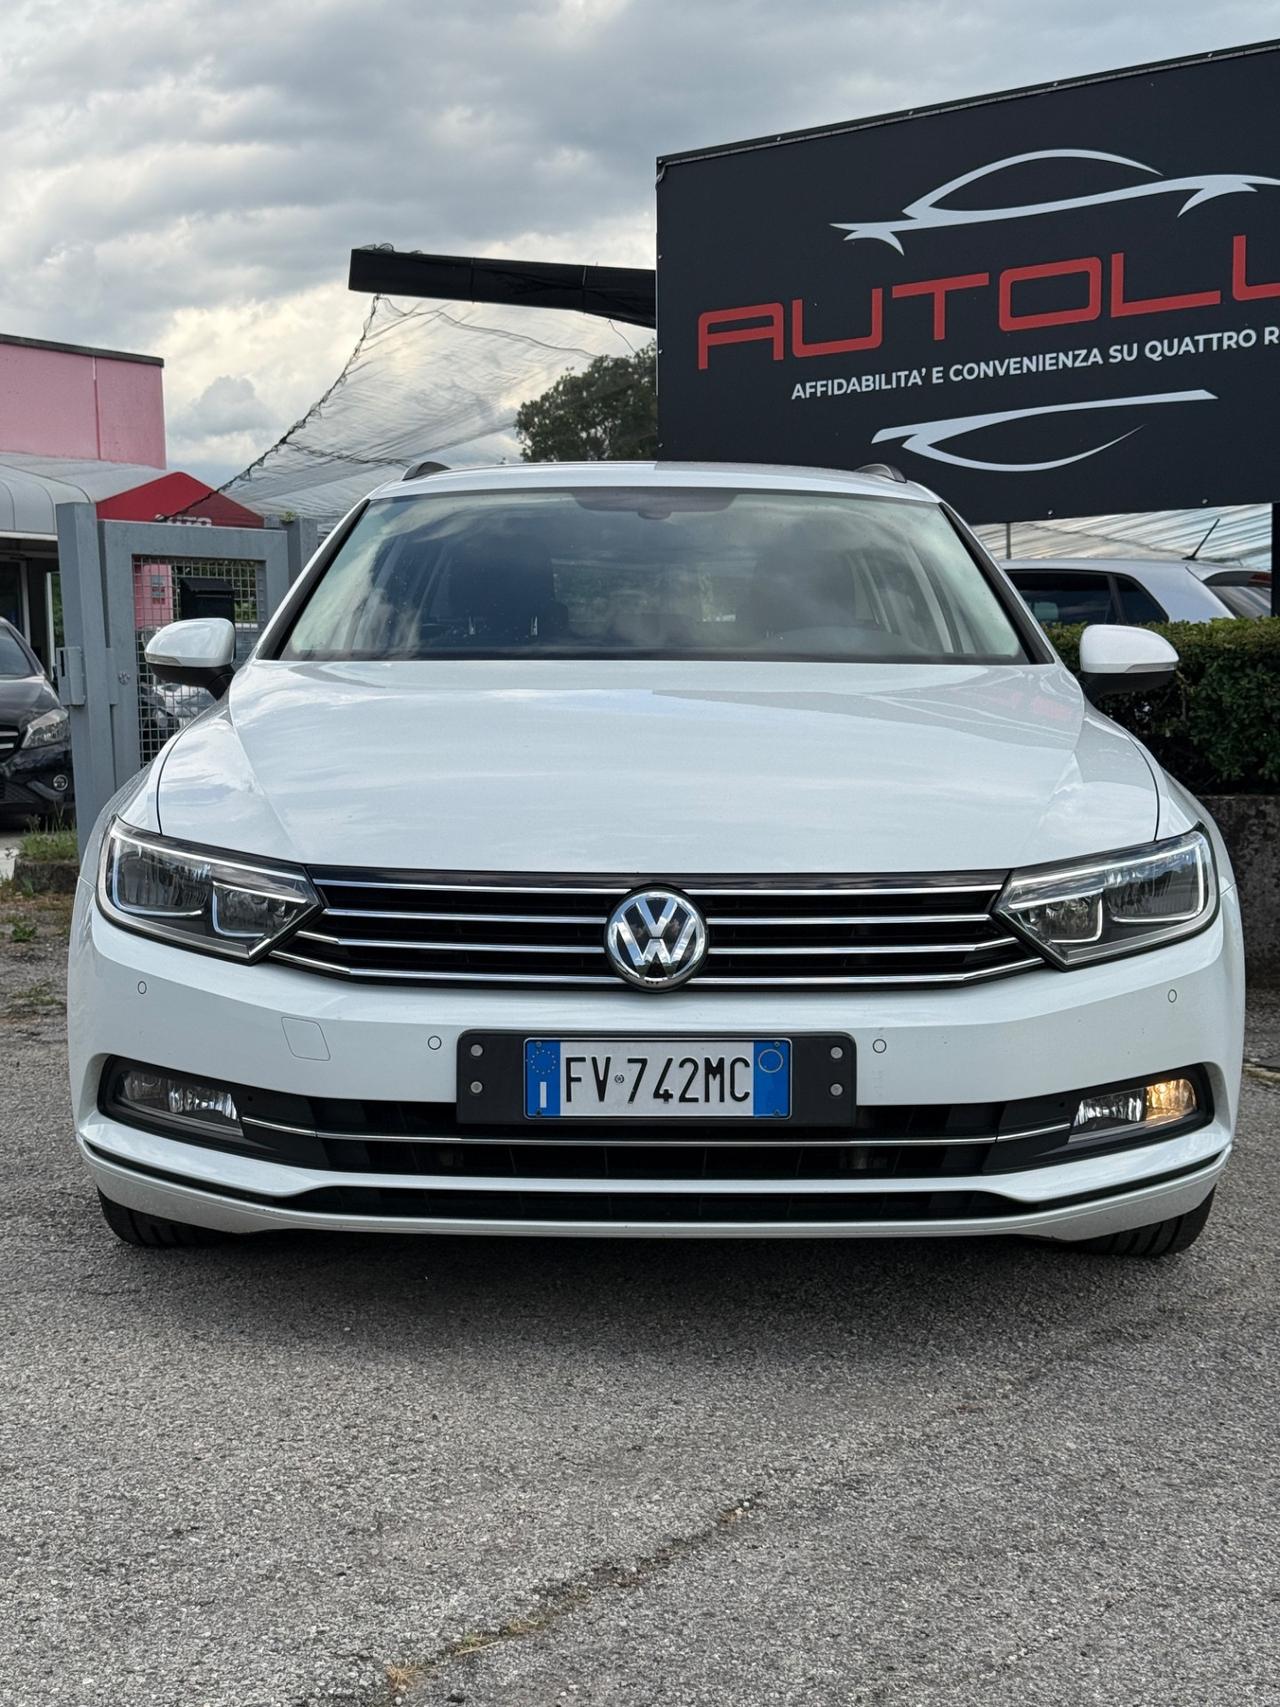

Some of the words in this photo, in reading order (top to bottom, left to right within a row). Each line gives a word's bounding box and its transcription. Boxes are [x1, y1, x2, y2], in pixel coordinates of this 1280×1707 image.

[932, 366, 944, 384] E
[949, 347, 1104, 382] CONVENIENZA
[1108, 342, 1138, 363] SU
[1144, 328, 1257, 362] QUATTRO
